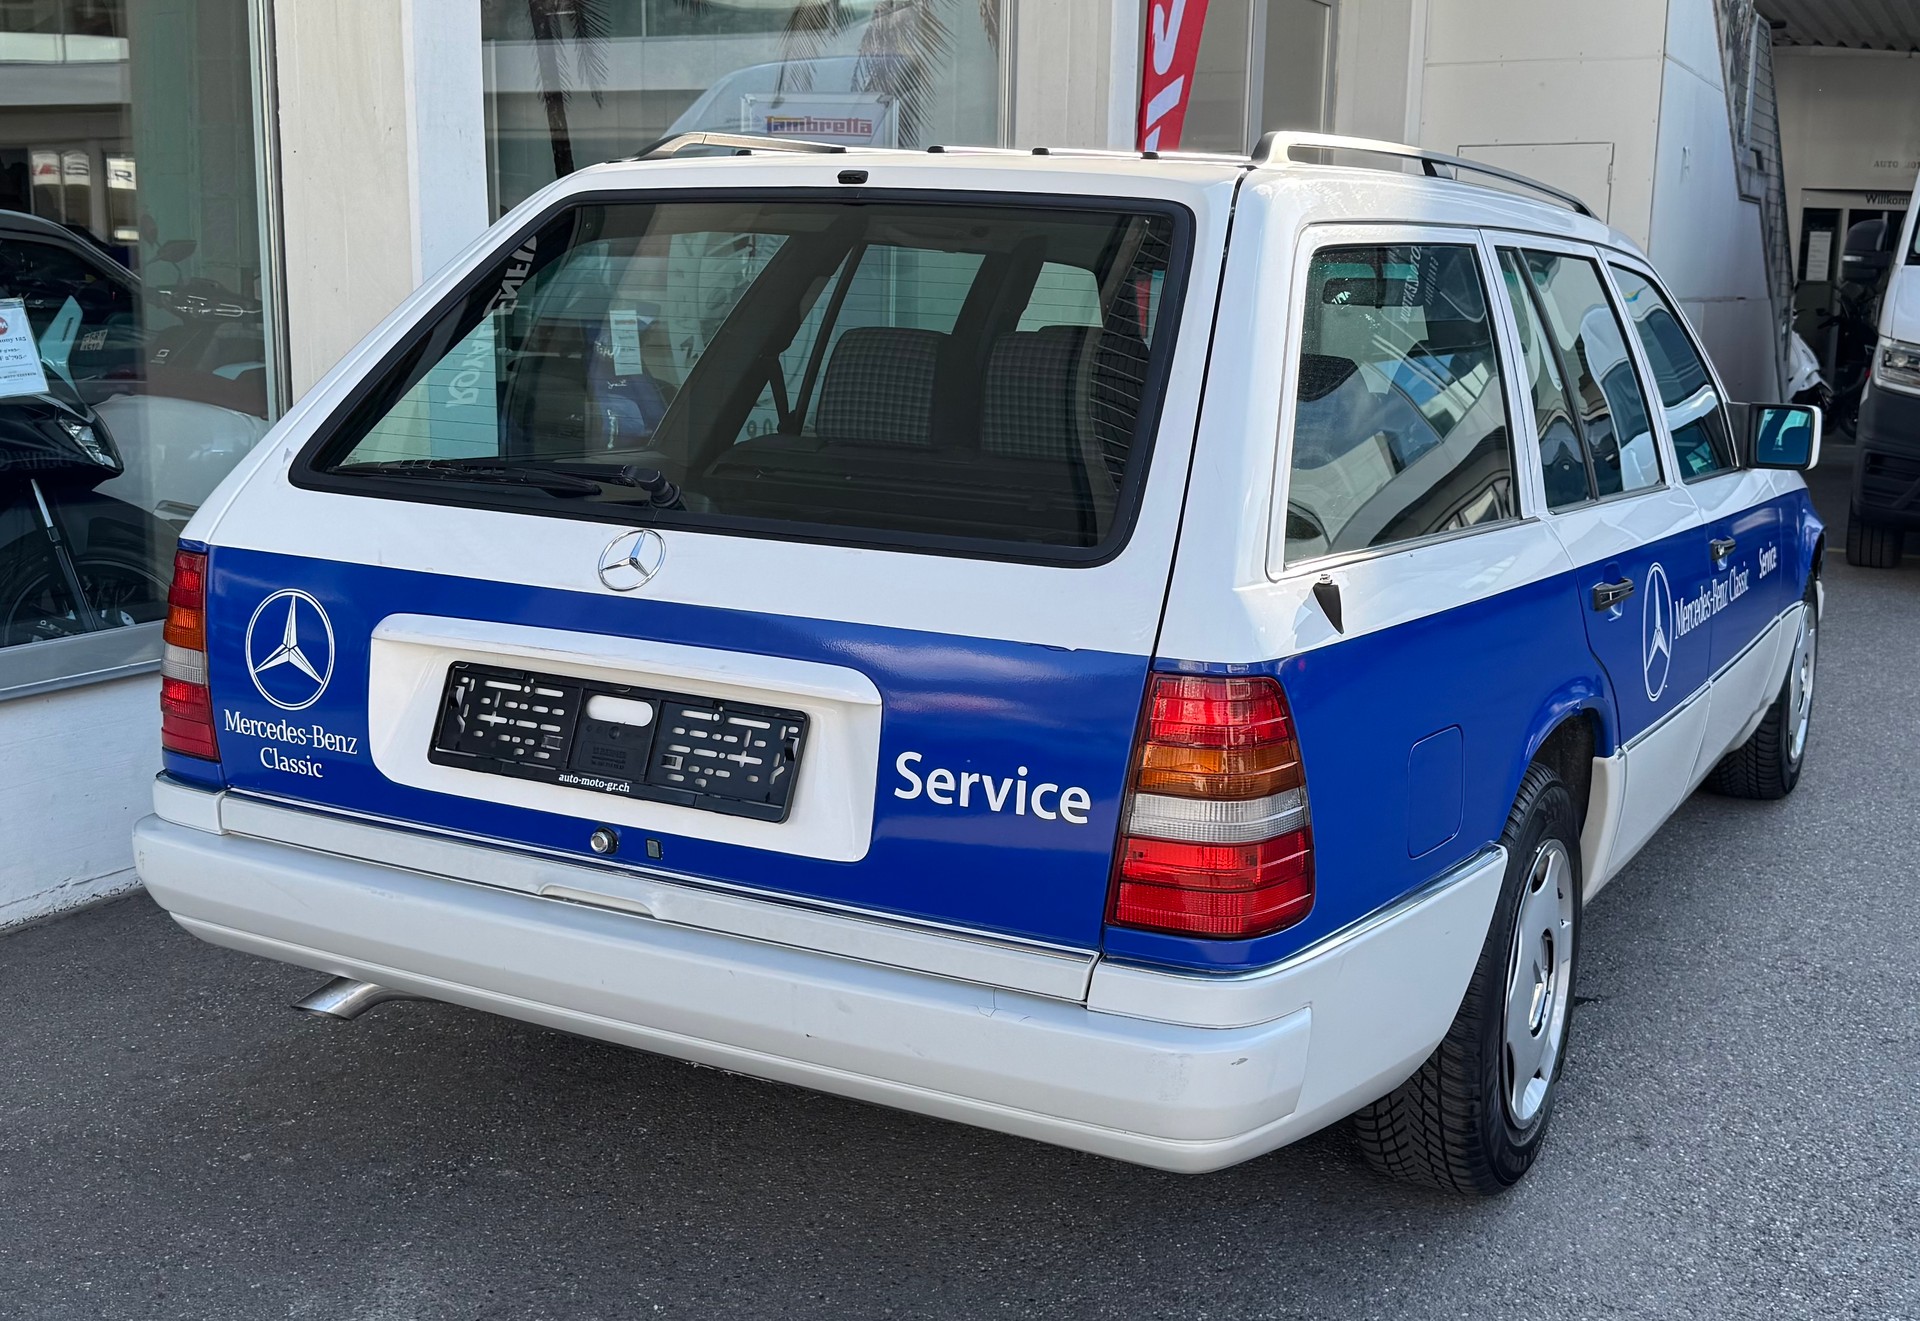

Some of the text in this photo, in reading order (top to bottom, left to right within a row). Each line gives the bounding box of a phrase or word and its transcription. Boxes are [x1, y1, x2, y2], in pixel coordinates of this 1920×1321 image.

[1674, 541, 1777, 640] Mercedes-Benz Classic Service
[224, 708, 358, 755] Mercedes-Benz
[260, 746, 323, 778] Classic
[558, 773, 630, 793] auto-moto-gr.ch
[893, 751, 1091, 824] Service
